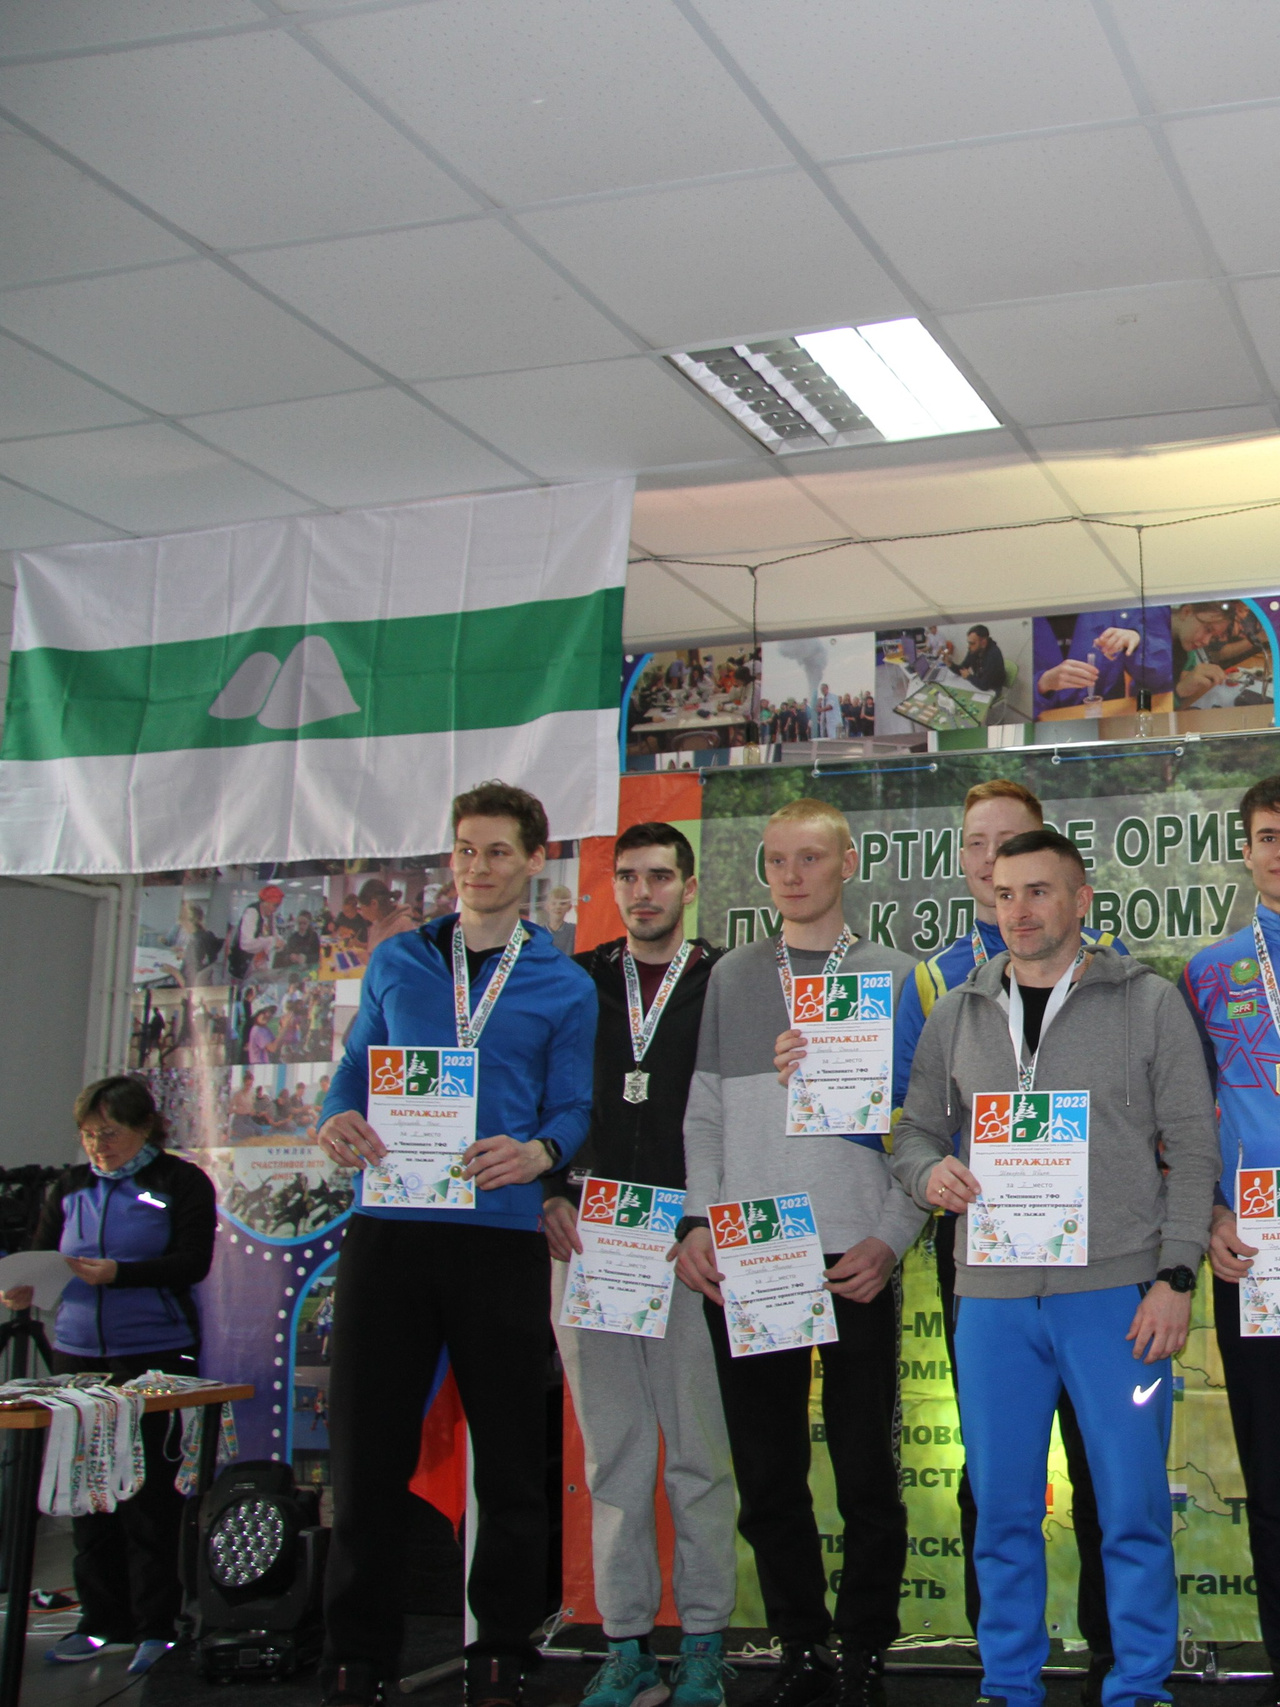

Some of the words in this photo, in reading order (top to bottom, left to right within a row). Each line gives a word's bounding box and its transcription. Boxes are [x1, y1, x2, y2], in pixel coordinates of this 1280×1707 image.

[869, 901, 898, 949] К
[912, 884, 1238, 951] ЗДВОМУ
[864, 977, 891, 989] 2023
[1232, 1002, 1252, 1014] SFR
[811, 1035, 878, 1044] НАГРАЖДАЕТ
[444, 1056, 472, 1066] 2023
[1055, 1097, 1087, 1108] 2023
[390, 1109, 458, 1118] НАГРАЖДАЕТ
[994, 1158, 1071, 1166] НАГРАЖДАЕТ
[780, 1196, 808, 1210] 2023
[597, 1237, 665, 1252] НАГРАЖДАЕТ
[740, 1251, 808, 1267] НАГРАЖДАЕТ
